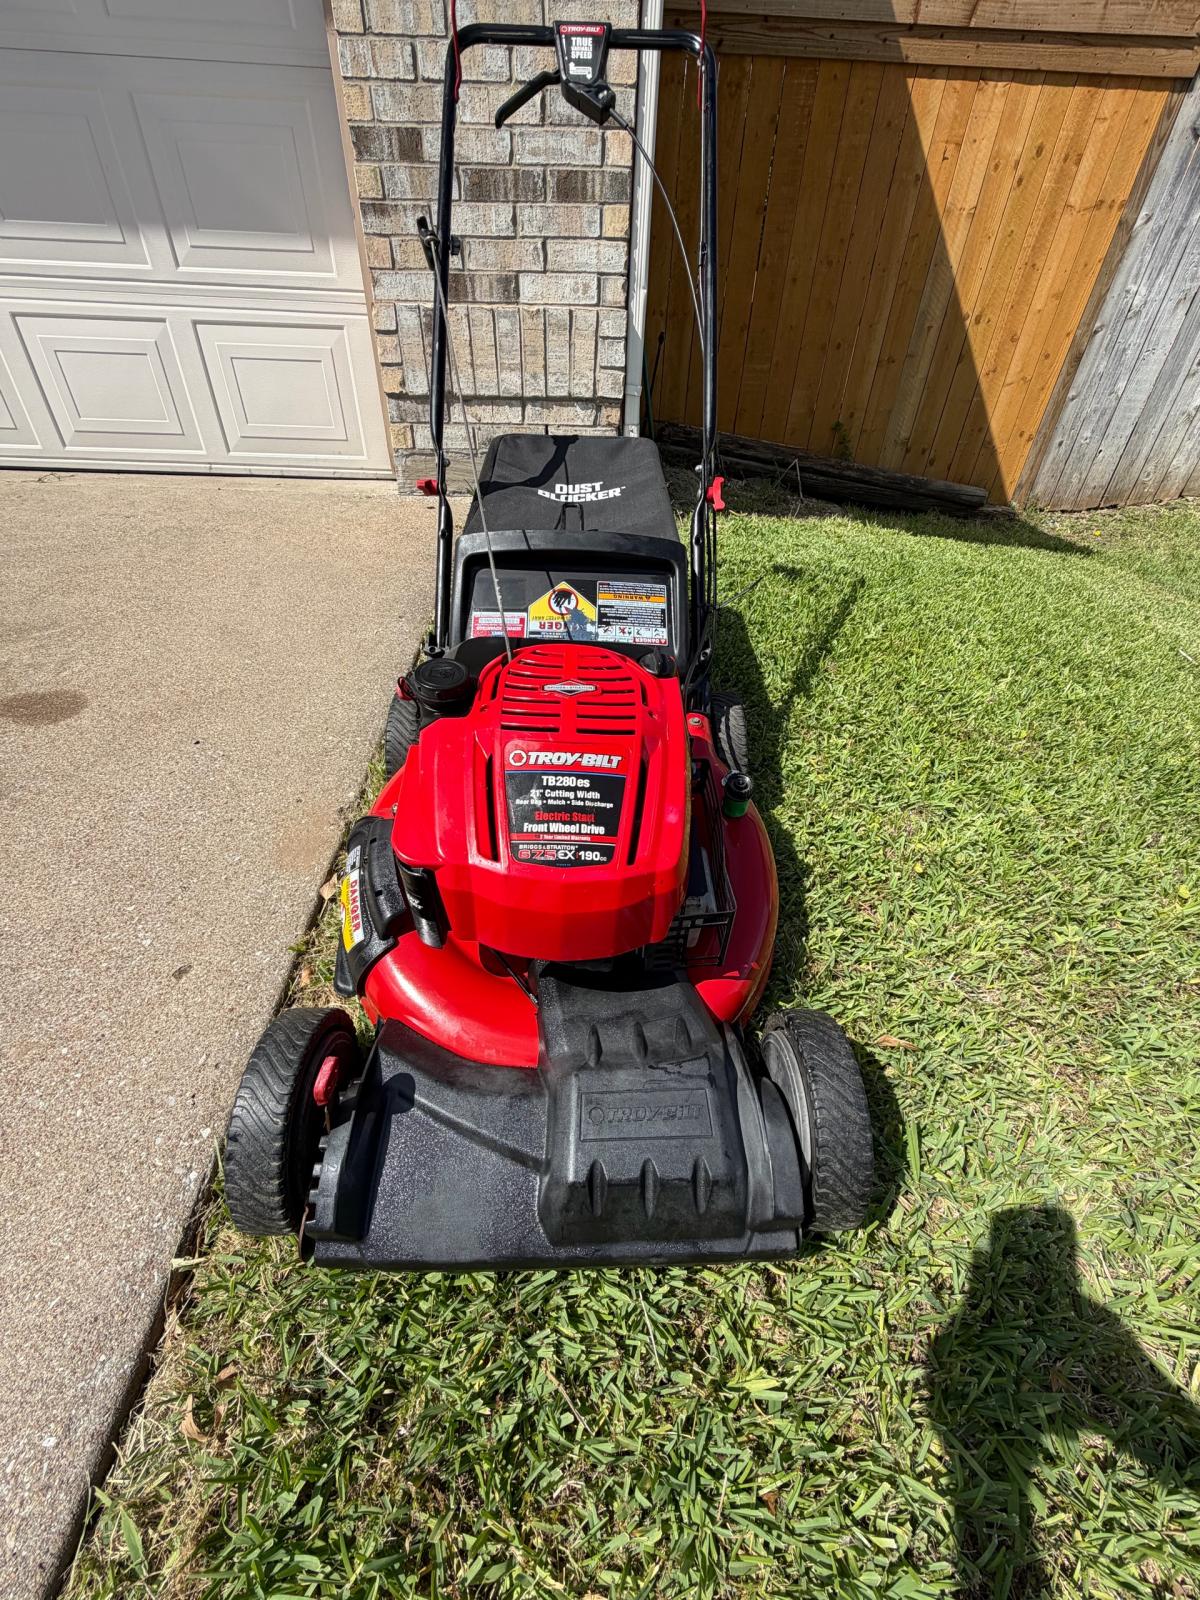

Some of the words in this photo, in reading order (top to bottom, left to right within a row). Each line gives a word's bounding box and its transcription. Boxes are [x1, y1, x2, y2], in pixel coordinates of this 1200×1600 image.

[571, 37, 592, 46] TRUE
[571, 51, 592, 59] SPEED
[555, 481, 603, 494] DUST
[537, 487, 622, 502] BLOCKER
[528, 752, 621, 768] TROY-BILT
[545, 789, 574, 799] Cutting
[576, 791, 600, 799] Width
[585, 800, 613, 808] Discharge
[535, 811, 571, 822] Electric
[572, 812, 595, 823] Start
[523, 823, 548, 833] Front
[549, 823, 579, 833] Wheel
[580, 824, 605, 834] Drive
[350, 880, 362, 932] DANGER
